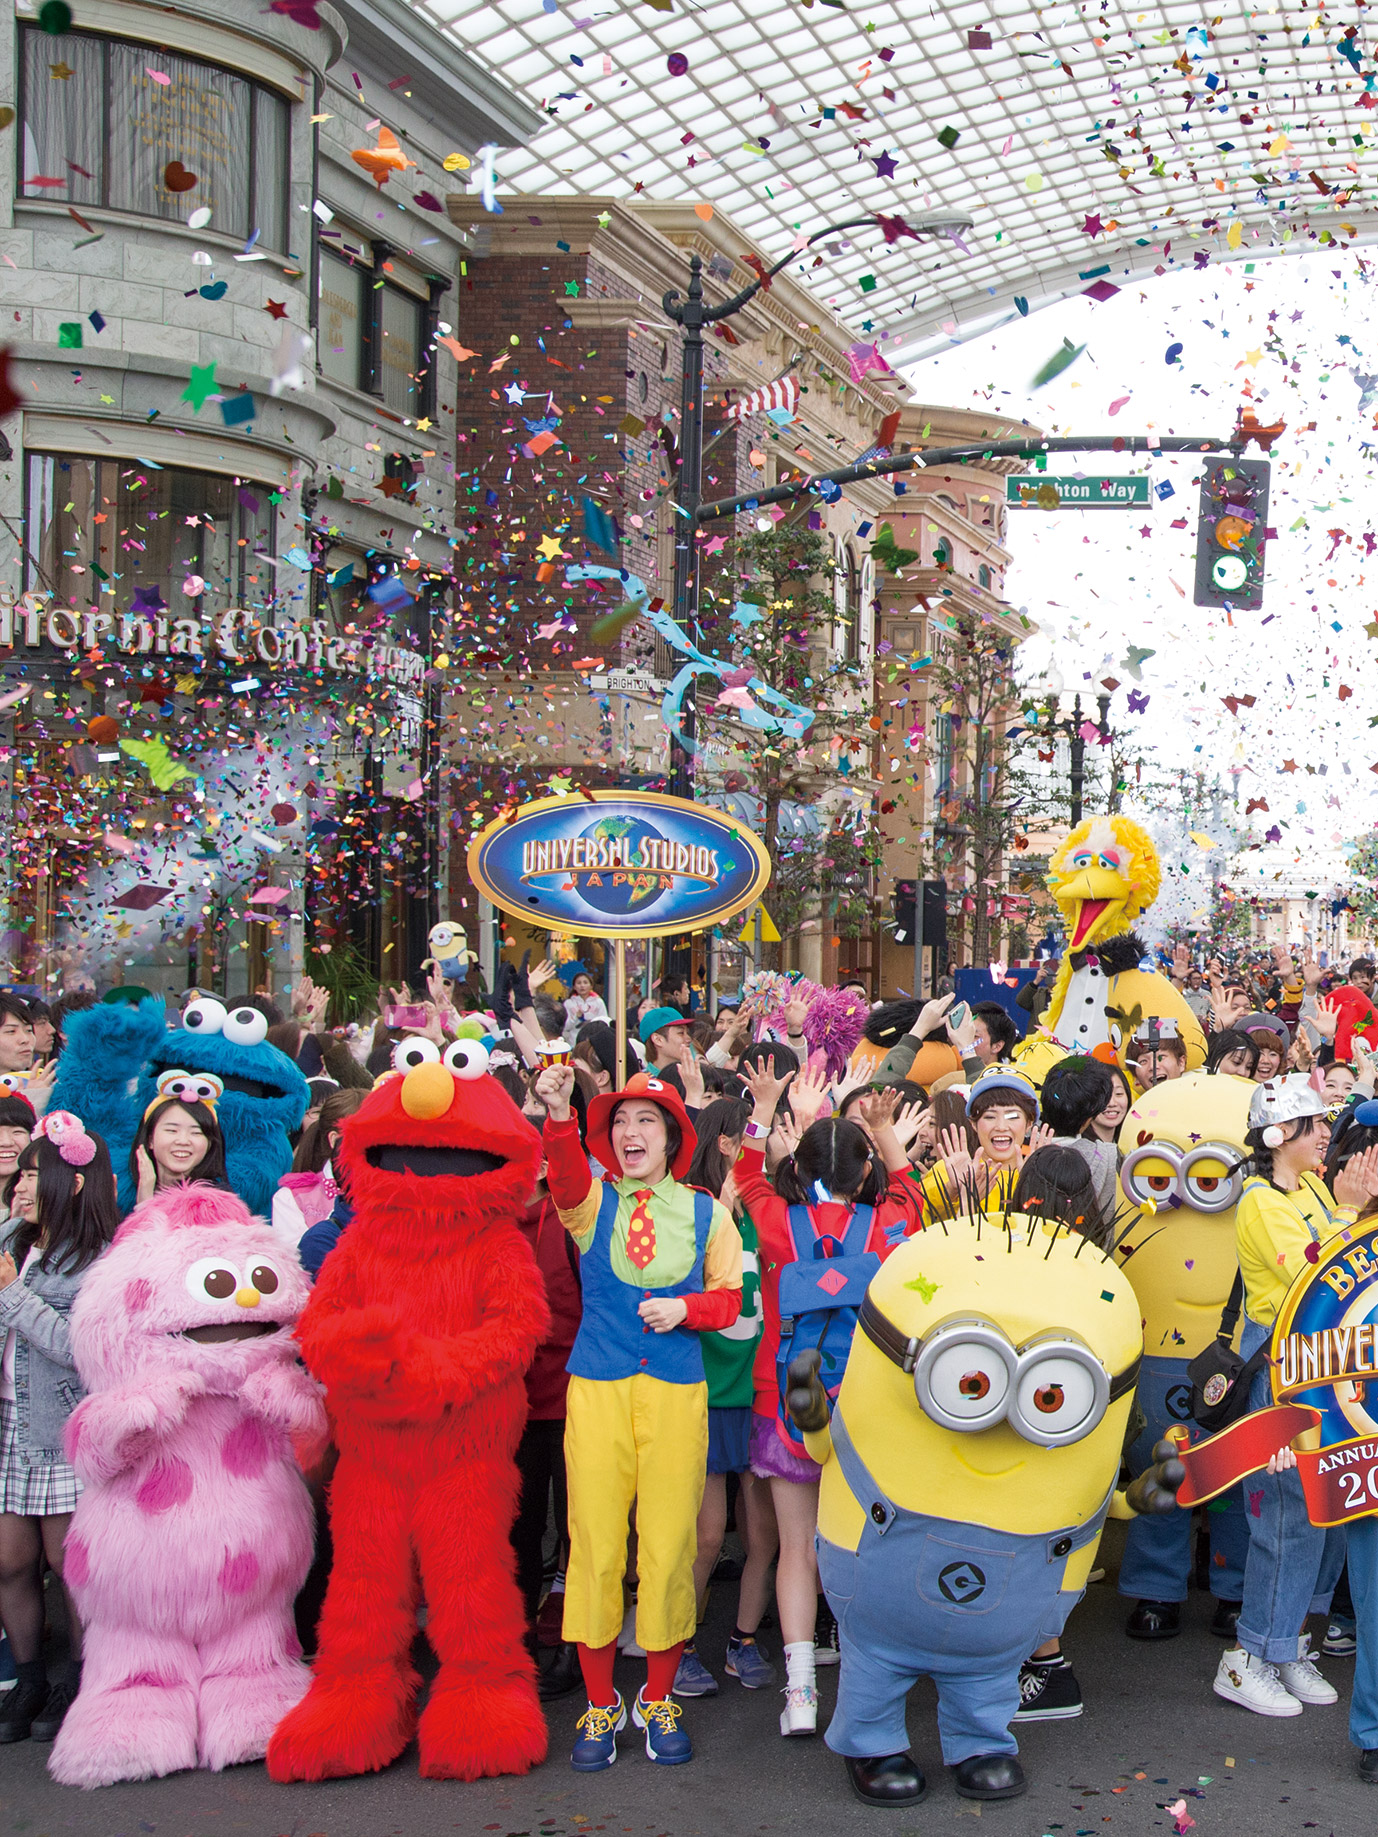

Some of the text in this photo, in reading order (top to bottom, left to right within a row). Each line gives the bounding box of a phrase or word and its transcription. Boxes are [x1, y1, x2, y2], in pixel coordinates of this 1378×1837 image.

[1019, 482, 1136, 500] Bhton Way
[607, 677, 651, 690] BRIGHTON
[522, 835, 720, 879] UNIVERSAL STUDIOS
[566, 872, 674, 889] JAPAN
